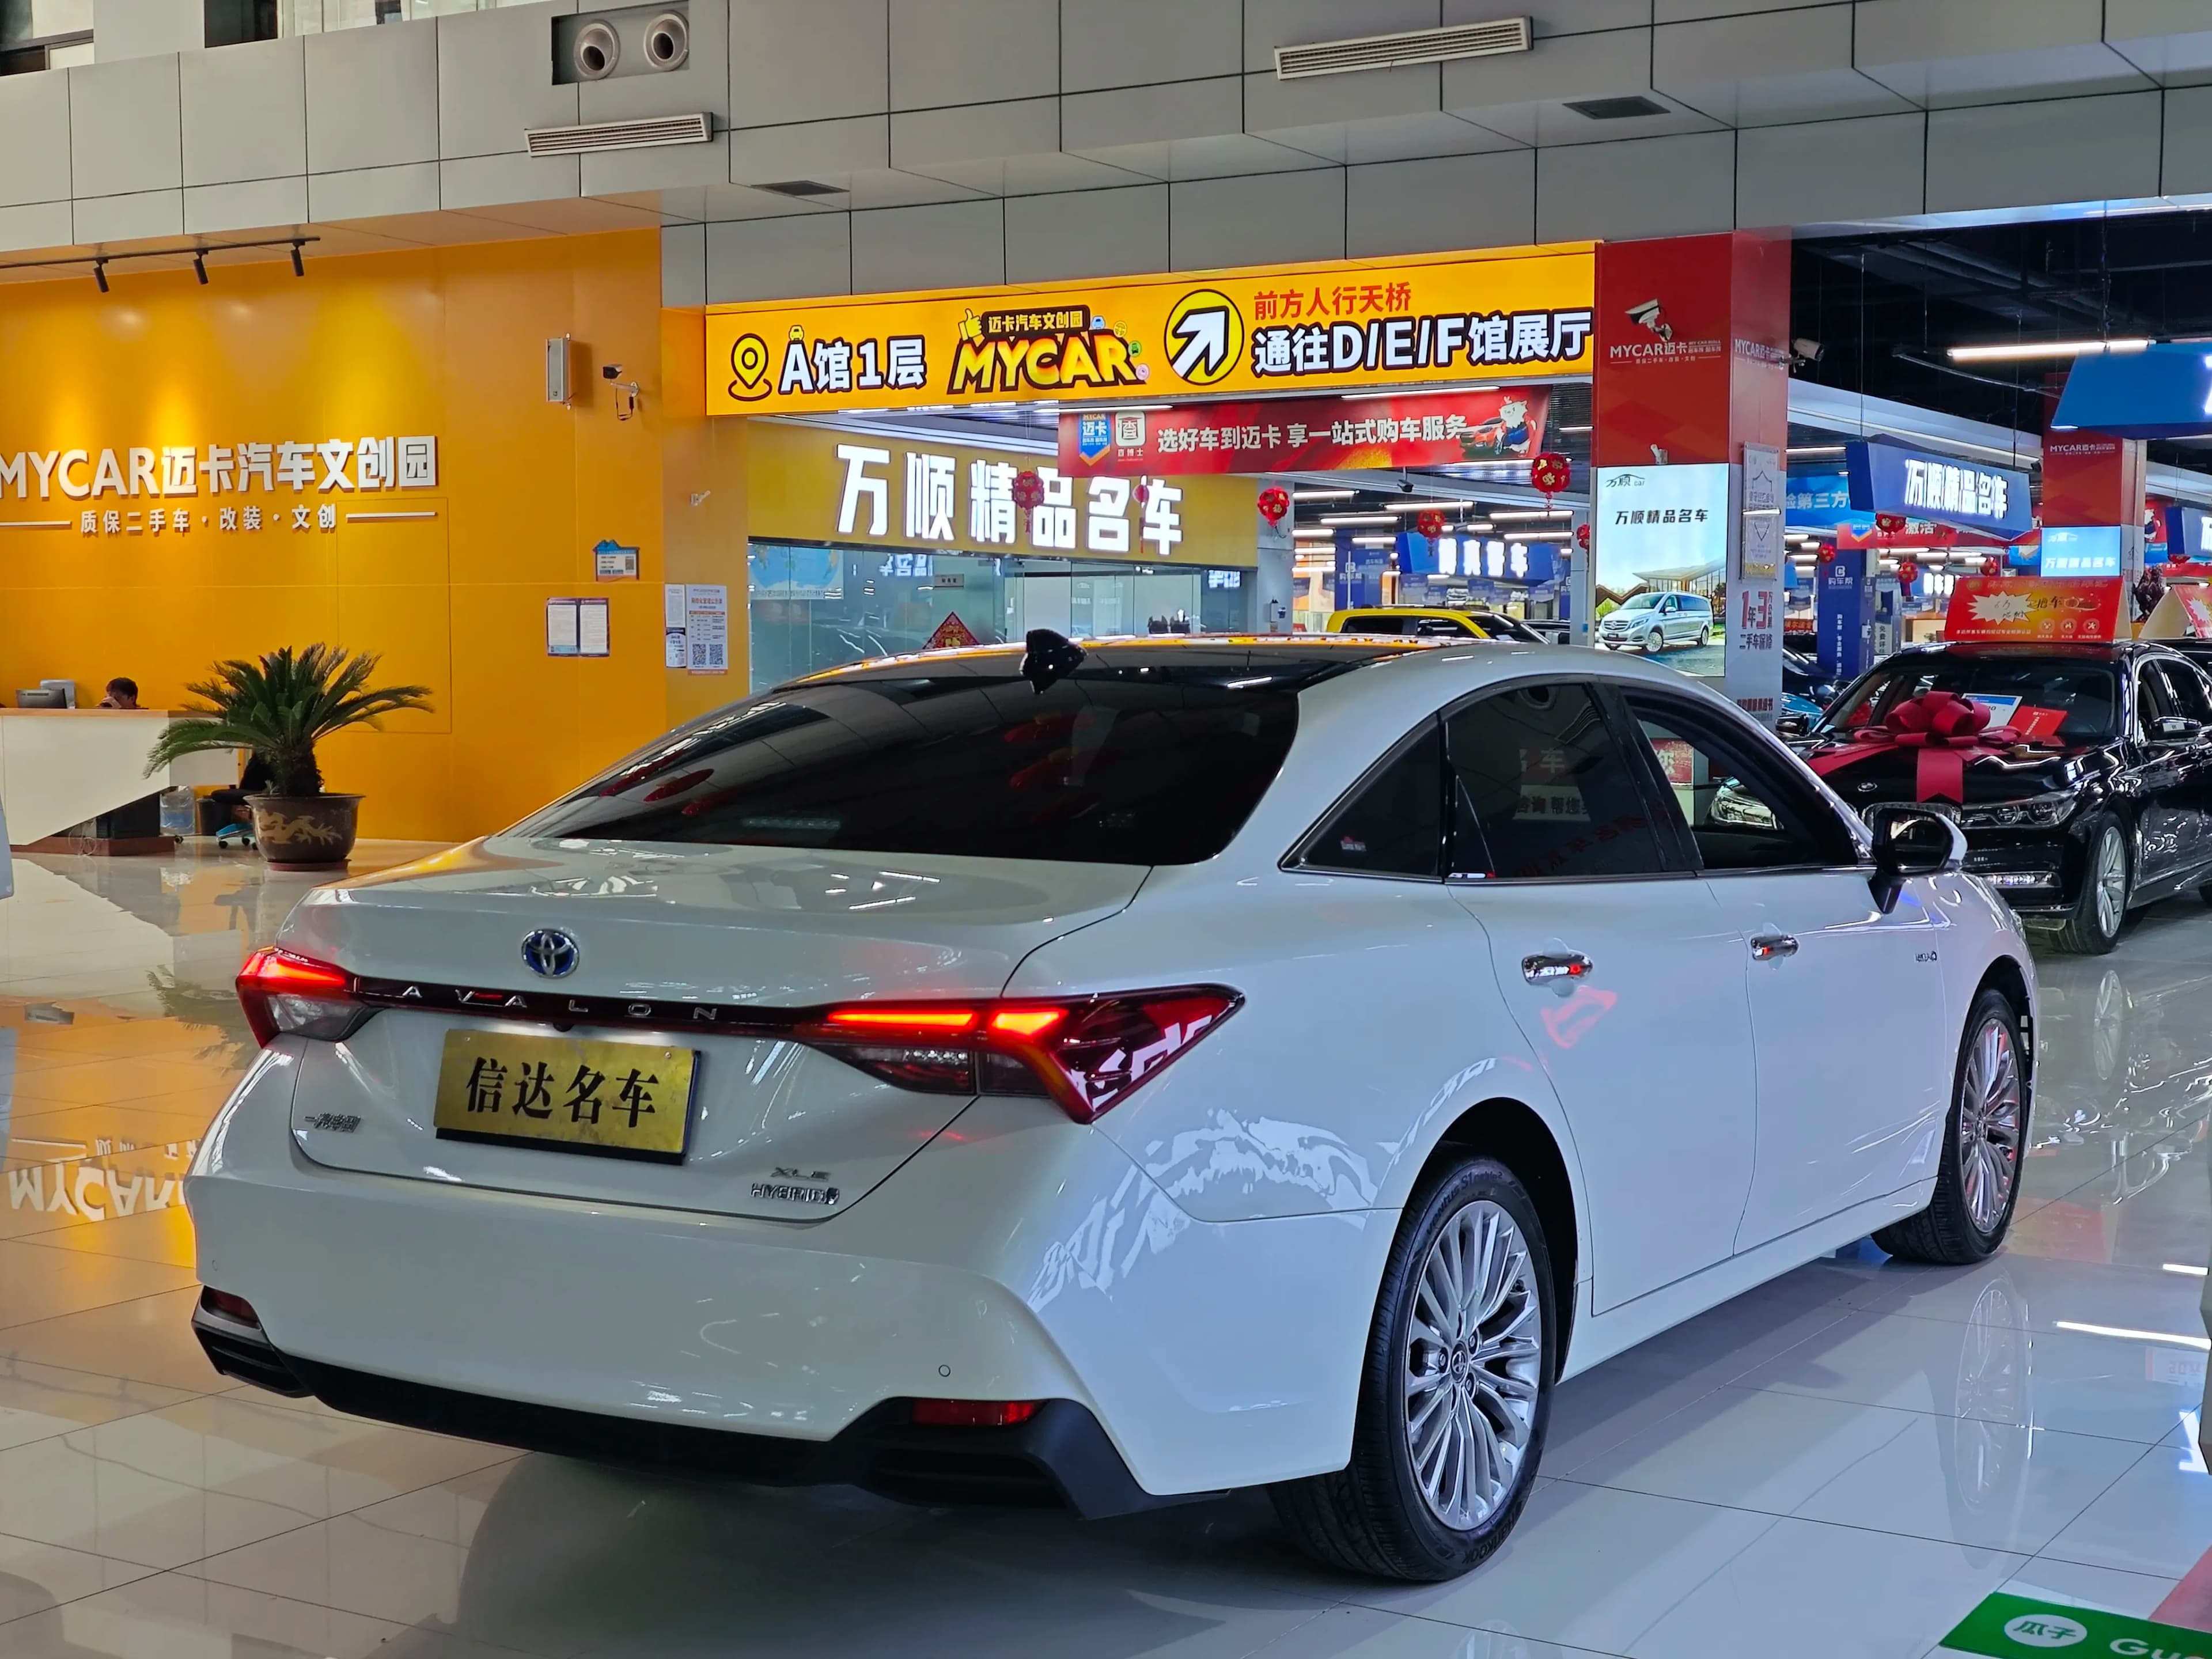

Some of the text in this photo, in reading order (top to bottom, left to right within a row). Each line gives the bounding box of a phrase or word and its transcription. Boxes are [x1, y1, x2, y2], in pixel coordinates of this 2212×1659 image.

[1253, 281, 1411, 320] 前方人行天桥
[988, 314, 1083, 334] 迈卡汽车文创园
[1253, 310, 1593, 374] 通往D/E/F馆展厅
[779, 338, 925, 393] A馆1层
[952, 334, 1138, 393] MYCAR
[1082, 421, 1107, 436] 迈卡
[1157, 414, 1467, 454] 选好车到迈卡 享一站式购车服务
[0, 435, 437, 498] MYCAR迈卡汽车文创园
[836, 444, 1183, 556] 万顺精品名车
[1615, 509, 1709, 525] 万顺精品名车
[402, 985, 718, 1021] AVALON
[465, 1056, 660, 1129] 信达名车
[751, 1183, 826, 1204] HYBRID
[771, 1167, 831, 1181] XLE
[2013, 1621, 2076, 1639] 瓜子
